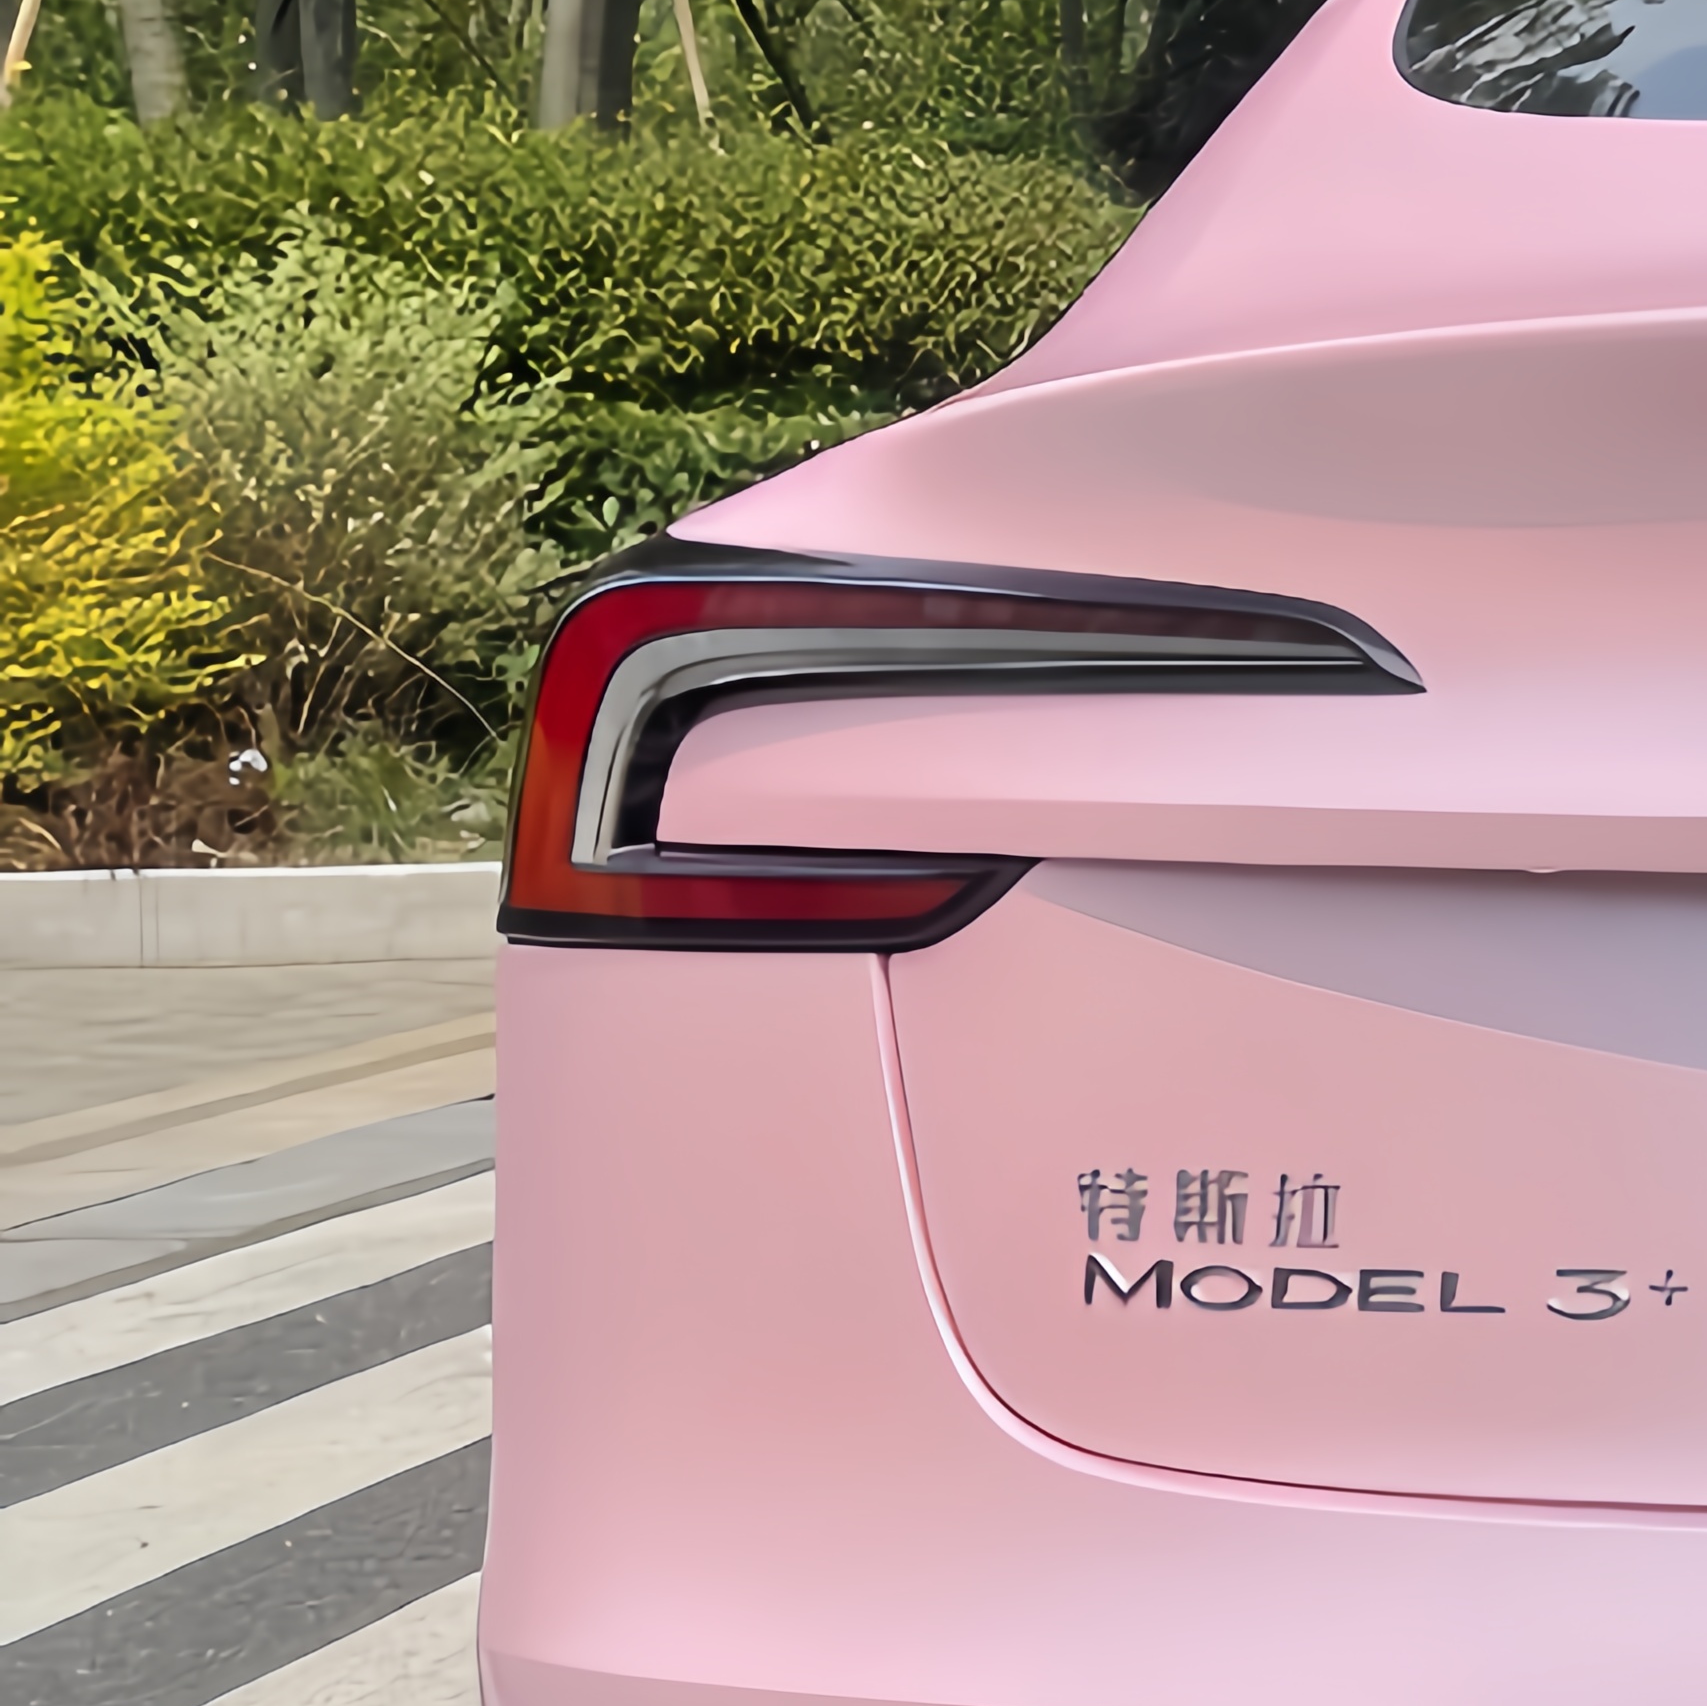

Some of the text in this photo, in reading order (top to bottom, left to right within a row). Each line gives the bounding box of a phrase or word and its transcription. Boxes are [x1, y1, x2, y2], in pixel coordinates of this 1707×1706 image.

[1077, 1168, 1341, 1248] 特斯拉
[1084, 1252, 1689, 1320] MODEL 3+
